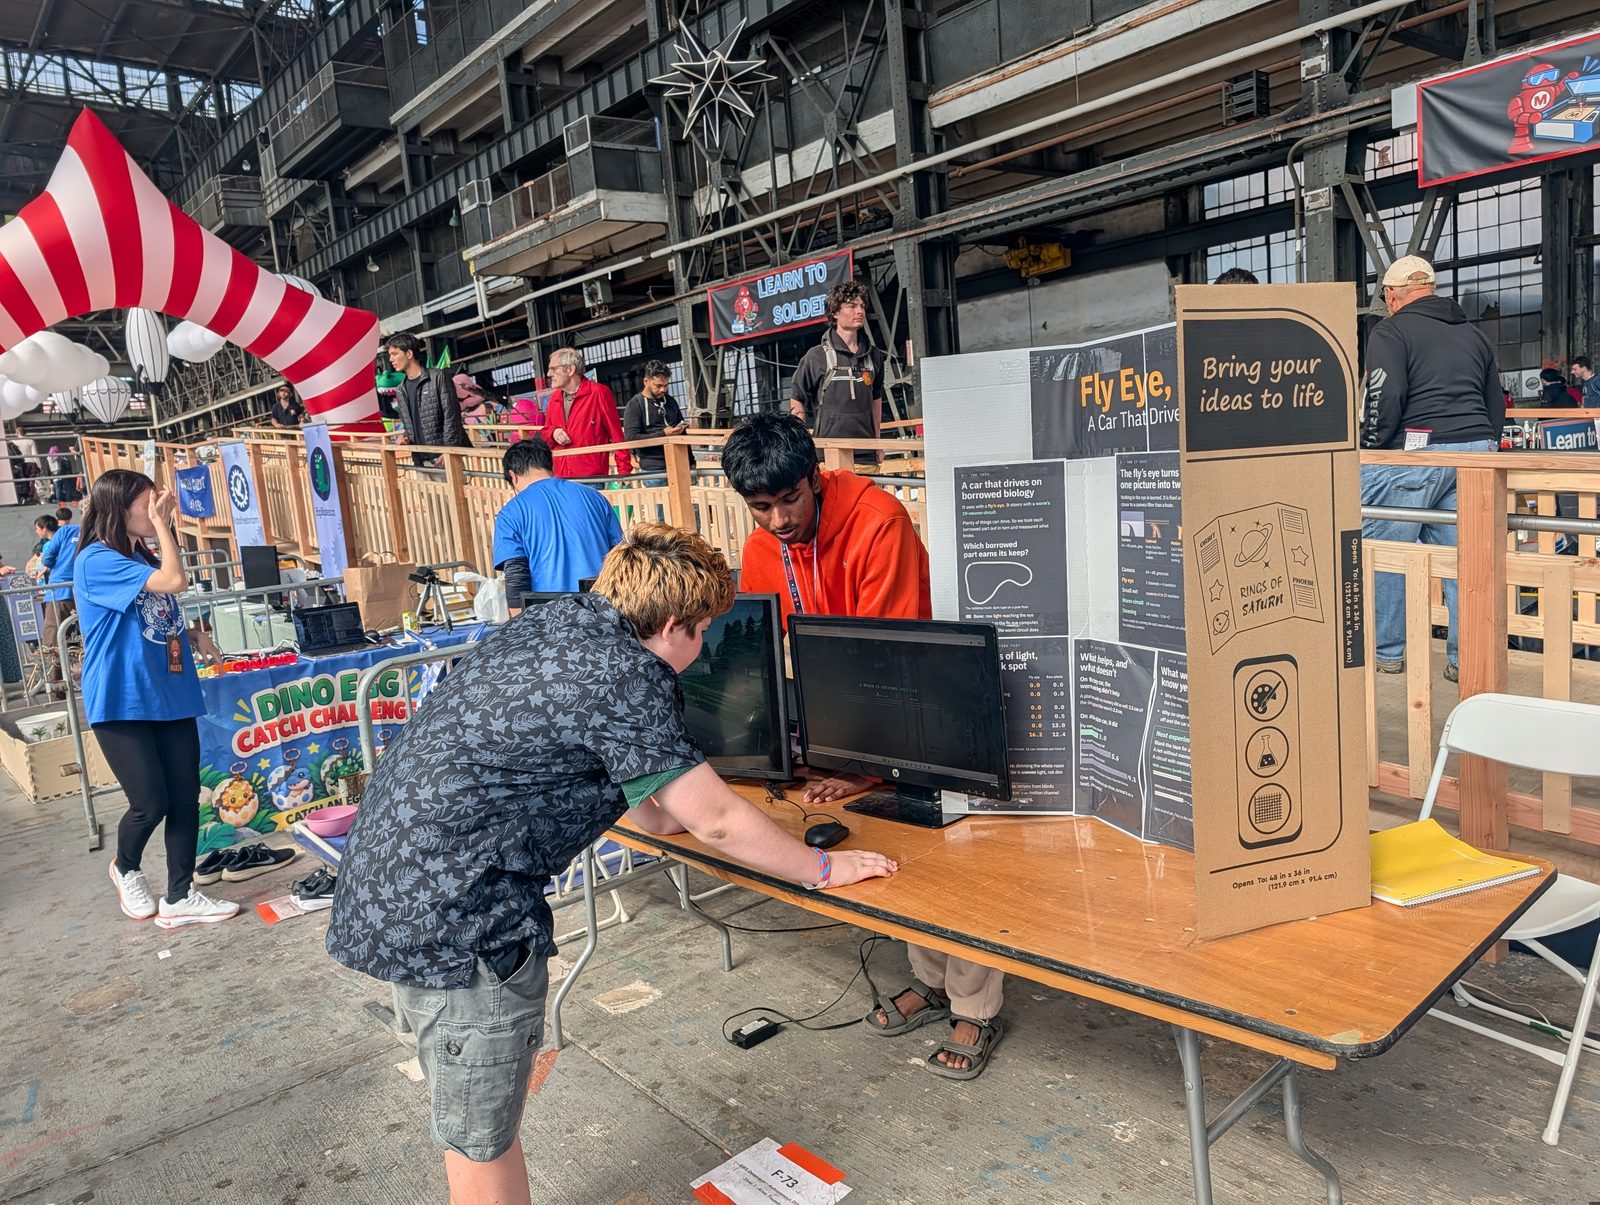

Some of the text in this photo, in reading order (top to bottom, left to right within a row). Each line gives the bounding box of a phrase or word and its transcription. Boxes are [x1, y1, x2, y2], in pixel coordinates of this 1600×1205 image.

[757, 262, 827, 298] LEARN TO
[1203, 354, 1321, 384] Bring your
[1080, 368, 1172, 412] Fly Eye,
[1200, 382, 1324, 412] ideas to life
[1088, 404, 1180, 432] A Car That Drive
[1546, 427, 1596, 449] Learn to
[1120, 469, 1179, 479] The fly's eye turns
[961, 482, 967, 490] A
[985, 480, 1001, 488] that
[1004, 479, 1029, 487] drives
[1133, 480, 1156, 491] picture
[1158, 480, 1170, 488] into
[962, 489, 1034, 500] borrowed biology
[963, 542, 984, 550] Which
[1200, 532, 1216, 547] ORBIT
[964, 551, 977, 559] part
[1009, 549, 1029, 557] keep?
[1240, 576, 1282, 598] RINGS OF
[1293, 577, 1314, 586] PHOEBE
[1242, 594, 1283, 616] SATURN
[1346, 606, 1350, 618] cm
[1354, 611, 1359, 621] 36
[1006, 651, 1038, 661] of light,
[1080, 653, 1128, 669] What helps, and
[1008, 662, 1028, 672] spot
[1096, 667, 1117, 678] doesn't
[1161, 666, 1179, 678] What
[1162, 677, 1187, 693] know ye
[256, 678, 335, 721] DINO
[237, 700, 417, 752] CATCH CHALENG
[347, 794, 361, 805] EG
[1232, 880, 1254, 889] Opens
[1268, 881, 1287, 891] (121.9
[1309, 874, 1322, 882] 91.4
[1324, 871, 1337, 880] cm)
[771, 1169, 799, 1188] F-73
